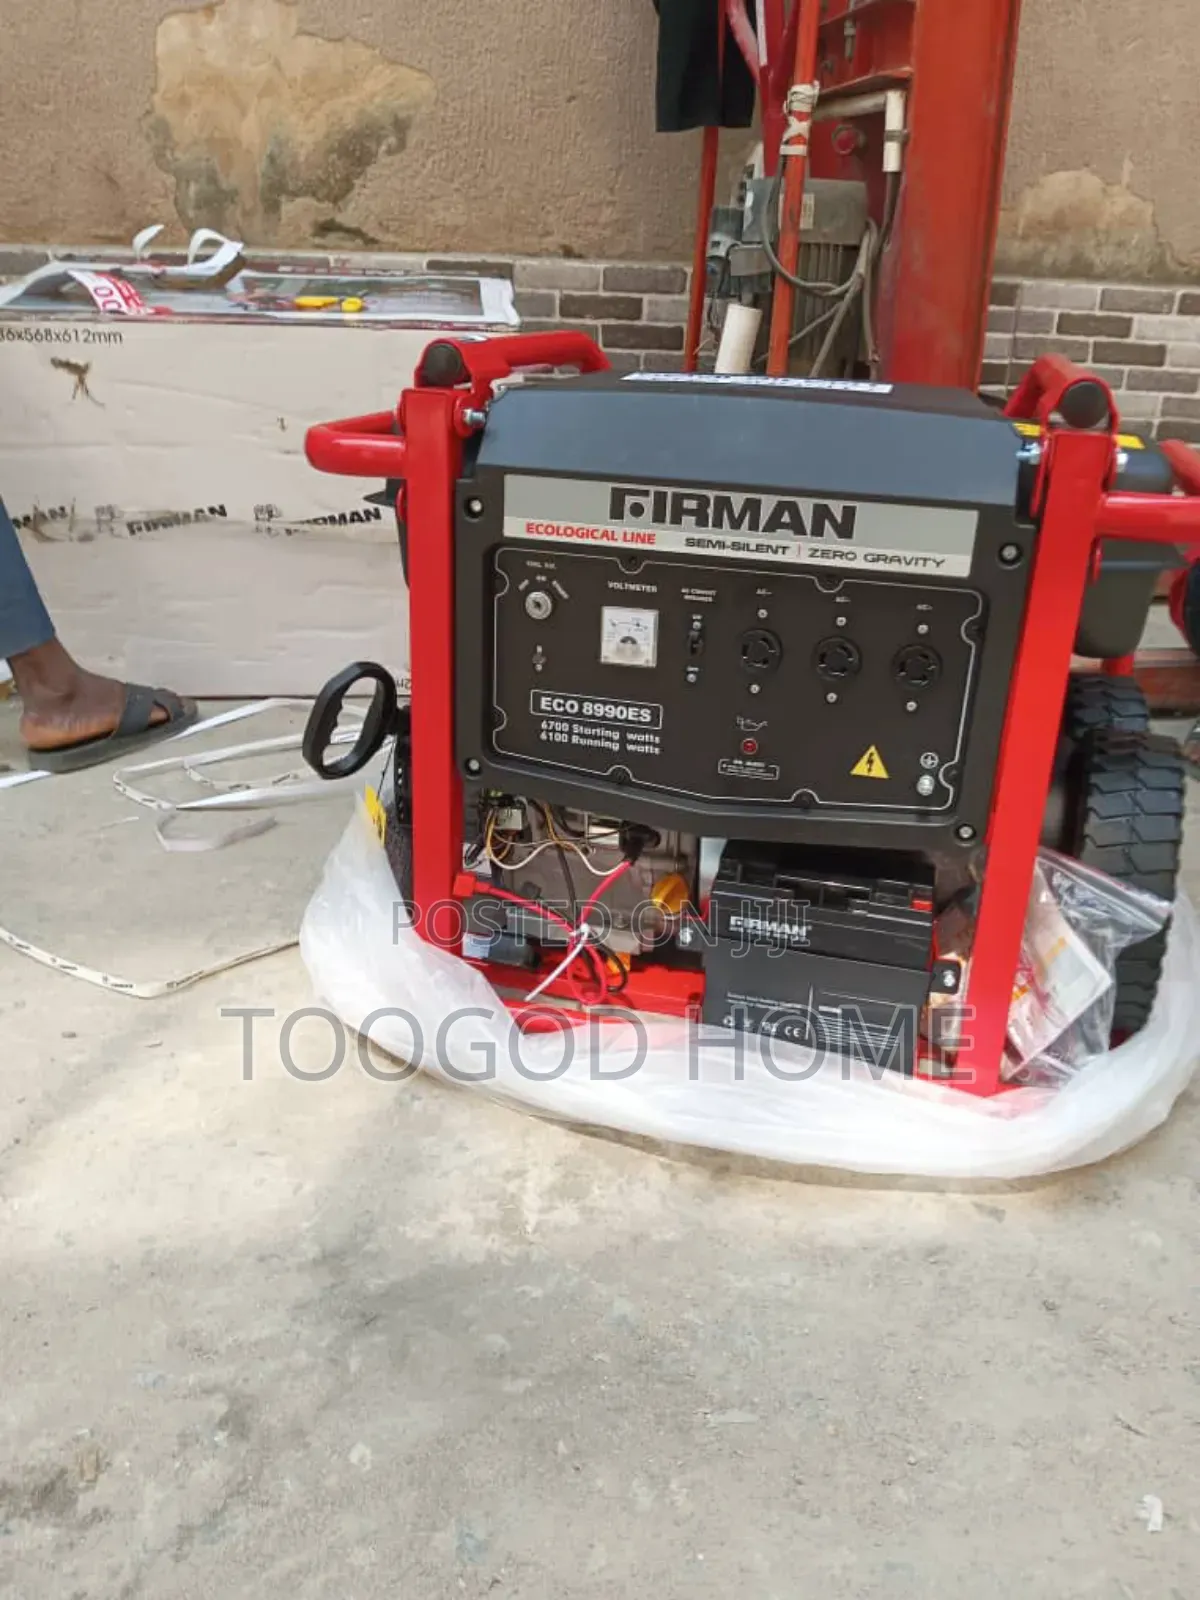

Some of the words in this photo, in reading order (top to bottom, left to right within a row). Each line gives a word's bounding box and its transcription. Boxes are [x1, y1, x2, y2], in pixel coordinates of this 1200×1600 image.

[609, 486, 857, 540] FIRMAN
[525, 522, 618, 543] ECOLOGICAL
[622, 531, 656, 545] LINE
[685, 536, 791, 556] SEMI-SILENT
[808, 547, 858, 562] ZERO
[863, 552, 946, 568] GRAVITY
[607, 580, 658, 593] VOLTMETER
[540, 696, 579, 713] ECO
[582, 701, 652, 722] 8990ES
[540, 731, 569, 743] 6100
[571, 734, 620, 752] Running
[626, 743, 660, 755] watts
[541, 720, 569, 732] 6700
[572, 723, 620, 740] Starting
[626, 732, 660, 744] watts
